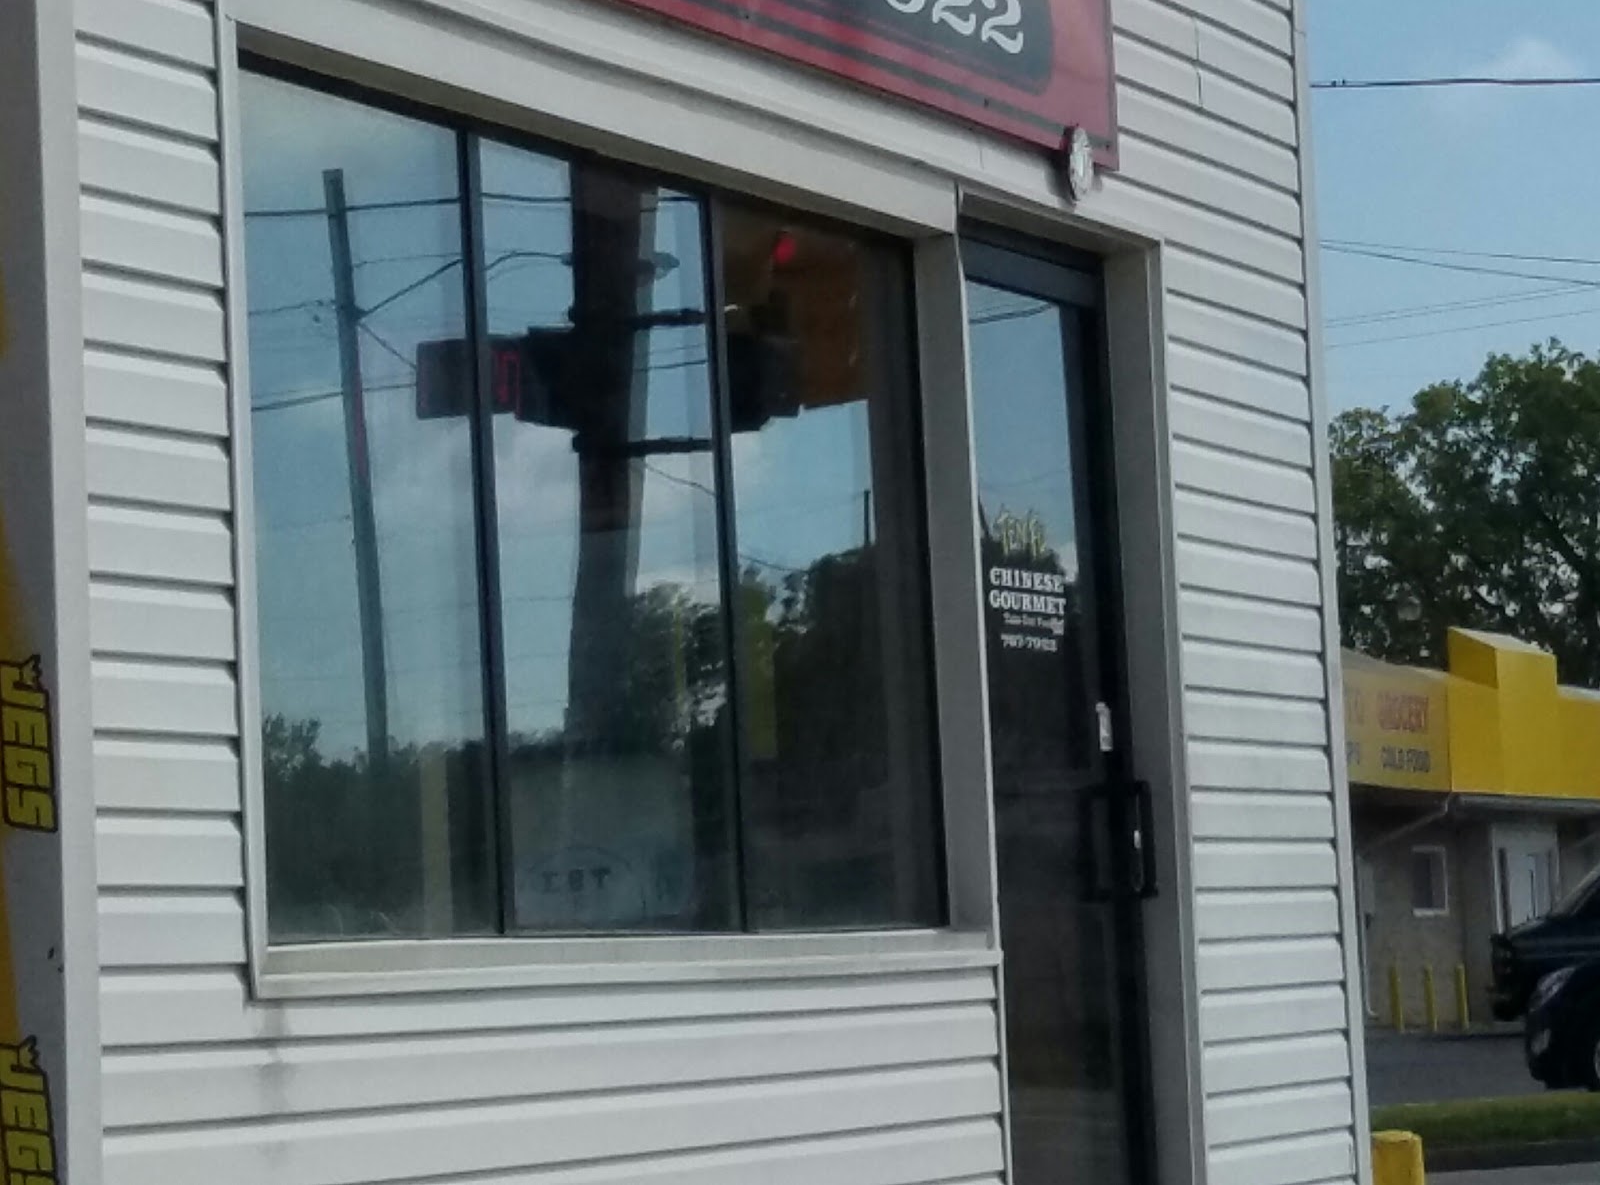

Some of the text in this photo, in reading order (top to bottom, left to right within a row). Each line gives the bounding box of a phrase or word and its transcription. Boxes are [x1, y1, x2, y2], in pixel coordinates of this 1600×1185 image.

[989, 567, 1065, 594] CHINESE
[988, 589, 1067, 616] GOURMET
[0, 656, 58, 833] JEGS
